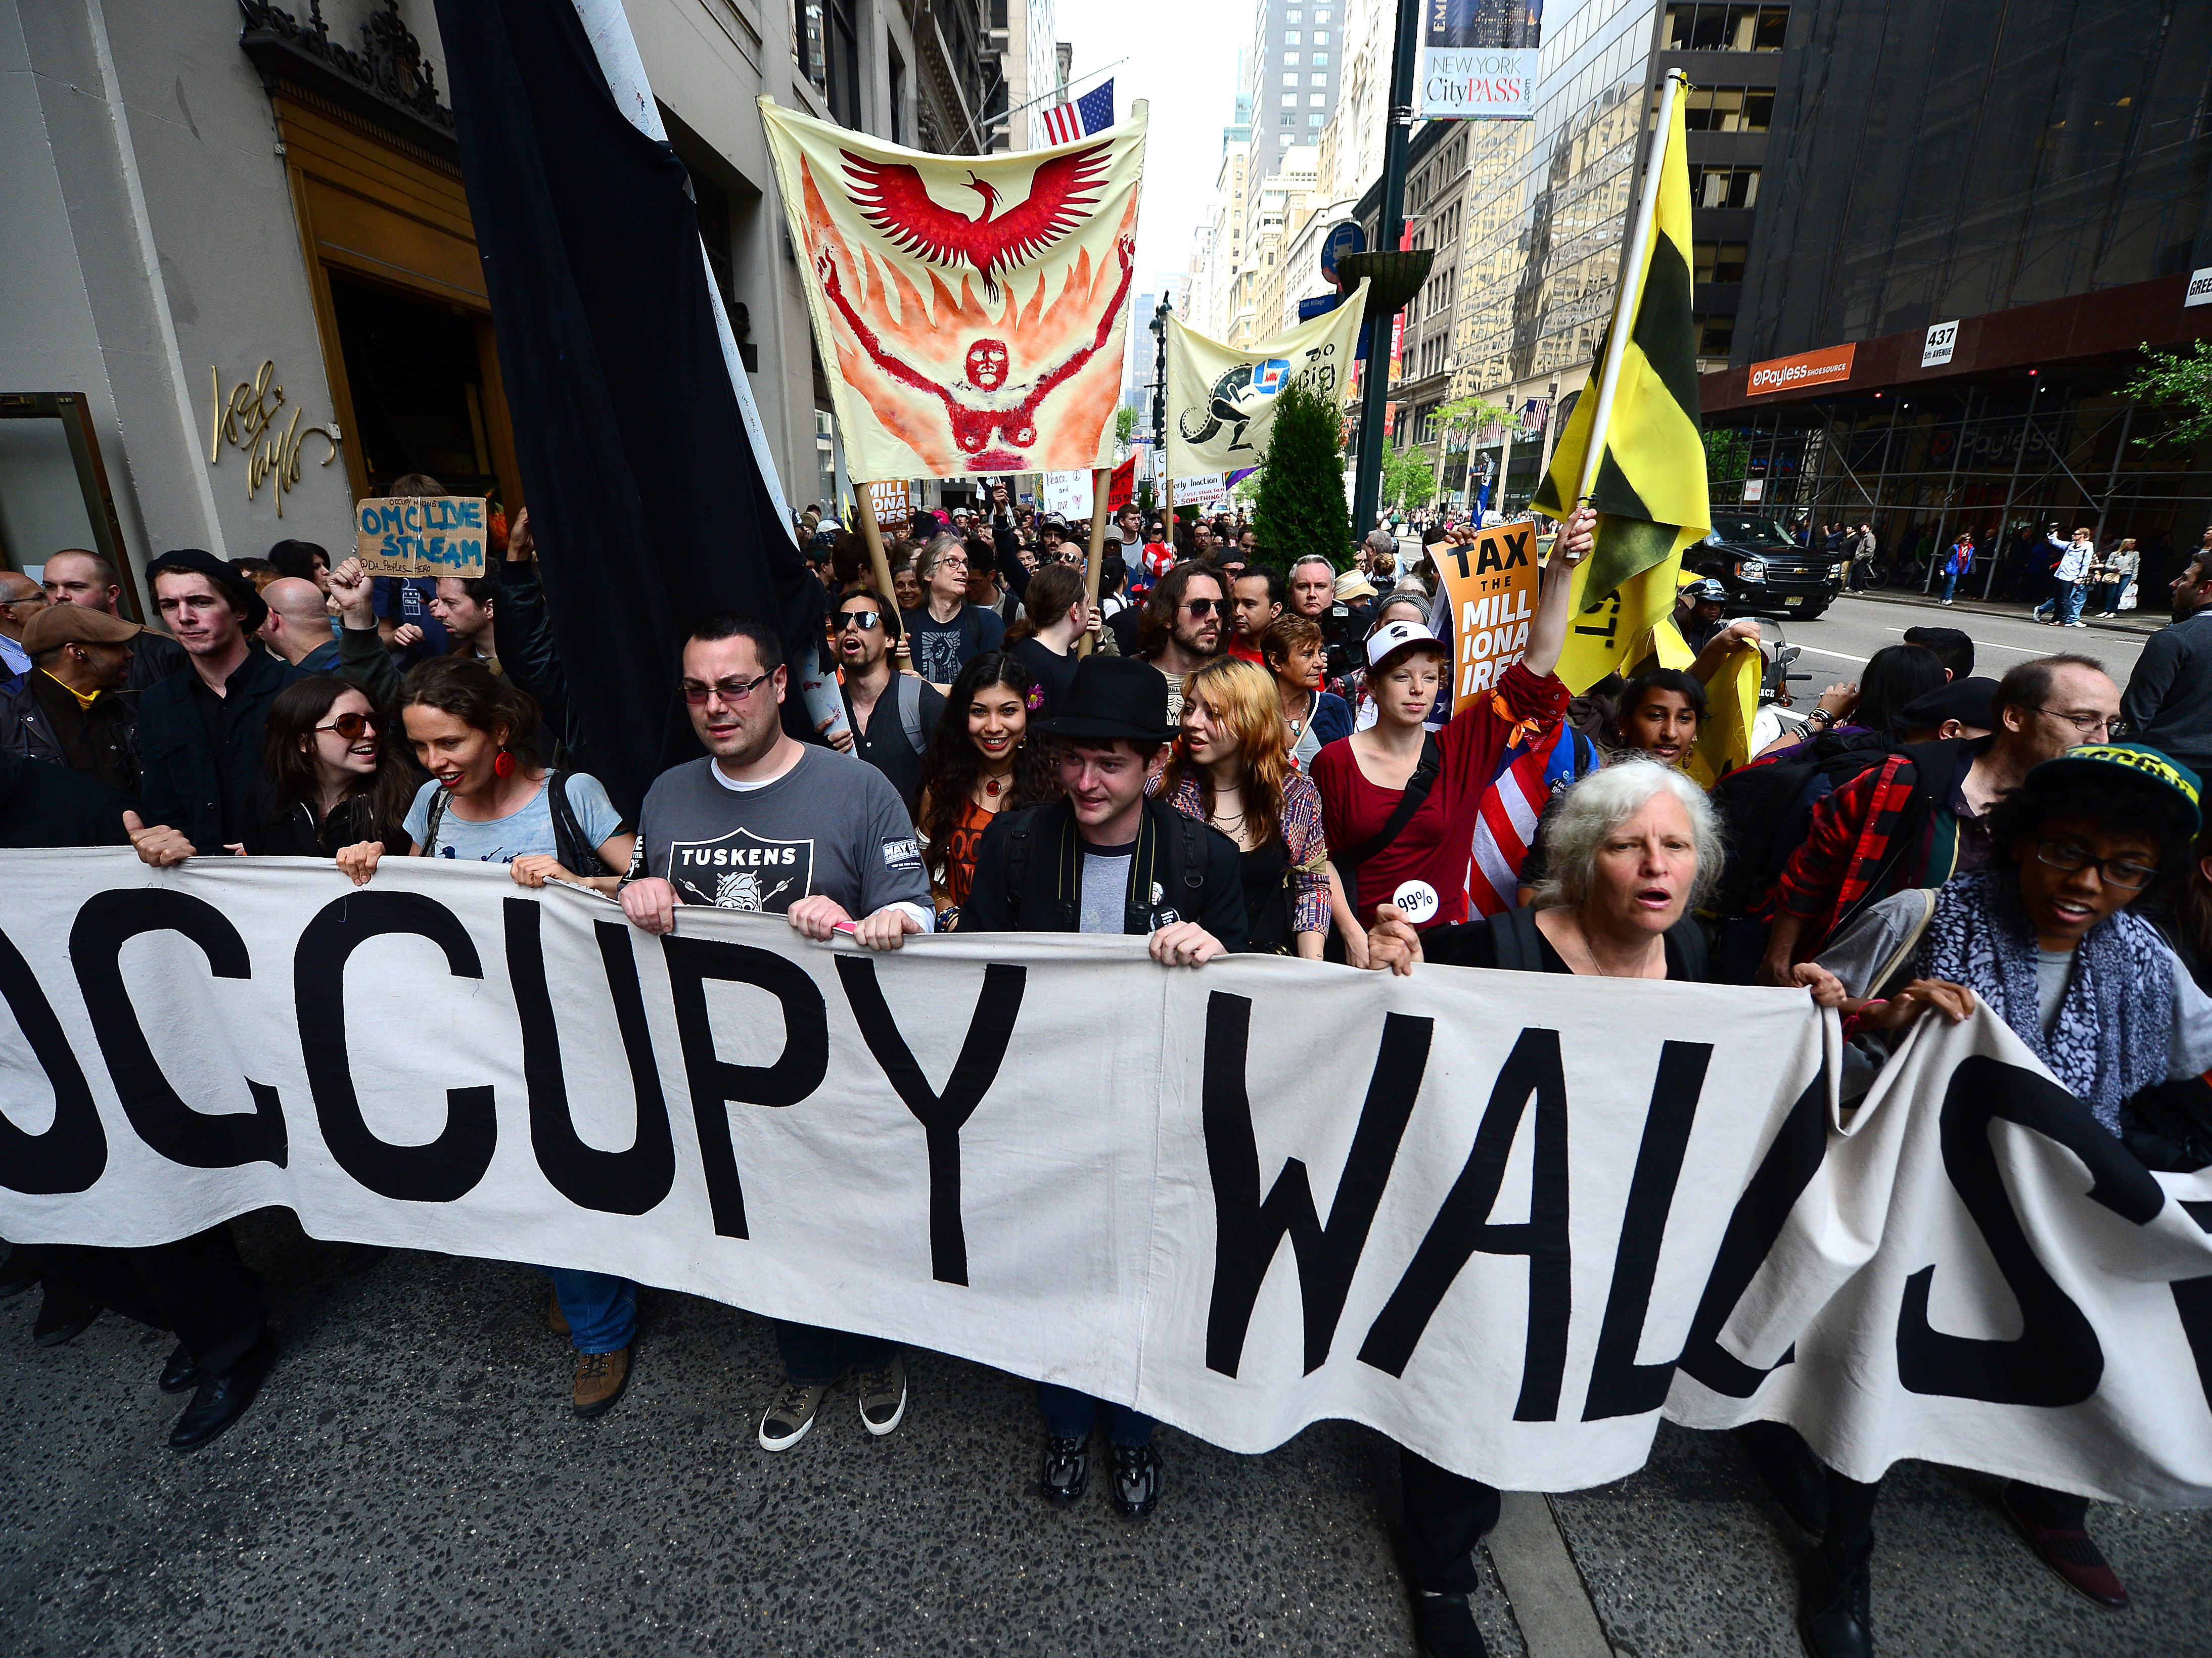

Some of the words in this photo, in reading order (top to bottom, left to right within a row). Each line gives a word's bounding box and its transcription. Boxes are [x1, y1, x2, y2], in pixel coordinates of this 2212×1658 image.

[1433, 0, 1447, 32] EM
[1433, 56, 1472, 74] NEW
[1477, 56, 1522, 74] YORK
[1426, 76, 1520, 107] CityPASS
[2190, 278, 2212, 296] GREE
[1927, 327, 1956, 346] 437
[1932, 347, 1953, 358] AVENUE
[1761, 364, 1808, 387] Payless
[1807, 362, 1847, 377] SHOESOURCE
[1046, 472, 1068, 486] Peace
[1161, 479, 1187, 491] Oerly
[1190, 477, 1218, 487] Inaction
[1058, 485, 1069, 494] and
[1181, 492, 1224, 504] SOMETHING!
[389, 498, 411, 507] OCCUPY
[871, 495, 906, 512] ONA
[1047, 498, 1069, 512] Love
[874, 509, 907, 525] RES
[380, 533, 483, 568] STREAM
[1446, 531, 1529, 579] TAX
[1481, 575, 1511, 592] THE
[1462, 589, 1532, 633] MILL
[1462, 621, 1529, 664] IONA
[681, 847, 797, 866] TUSKENS
[884, 843, 907, 857] MAY
[1397, 889, 1433, 912] 99%
[1202, 989, 1827, 1422] WALL
[1897, 1055, 2212, 1413] S
